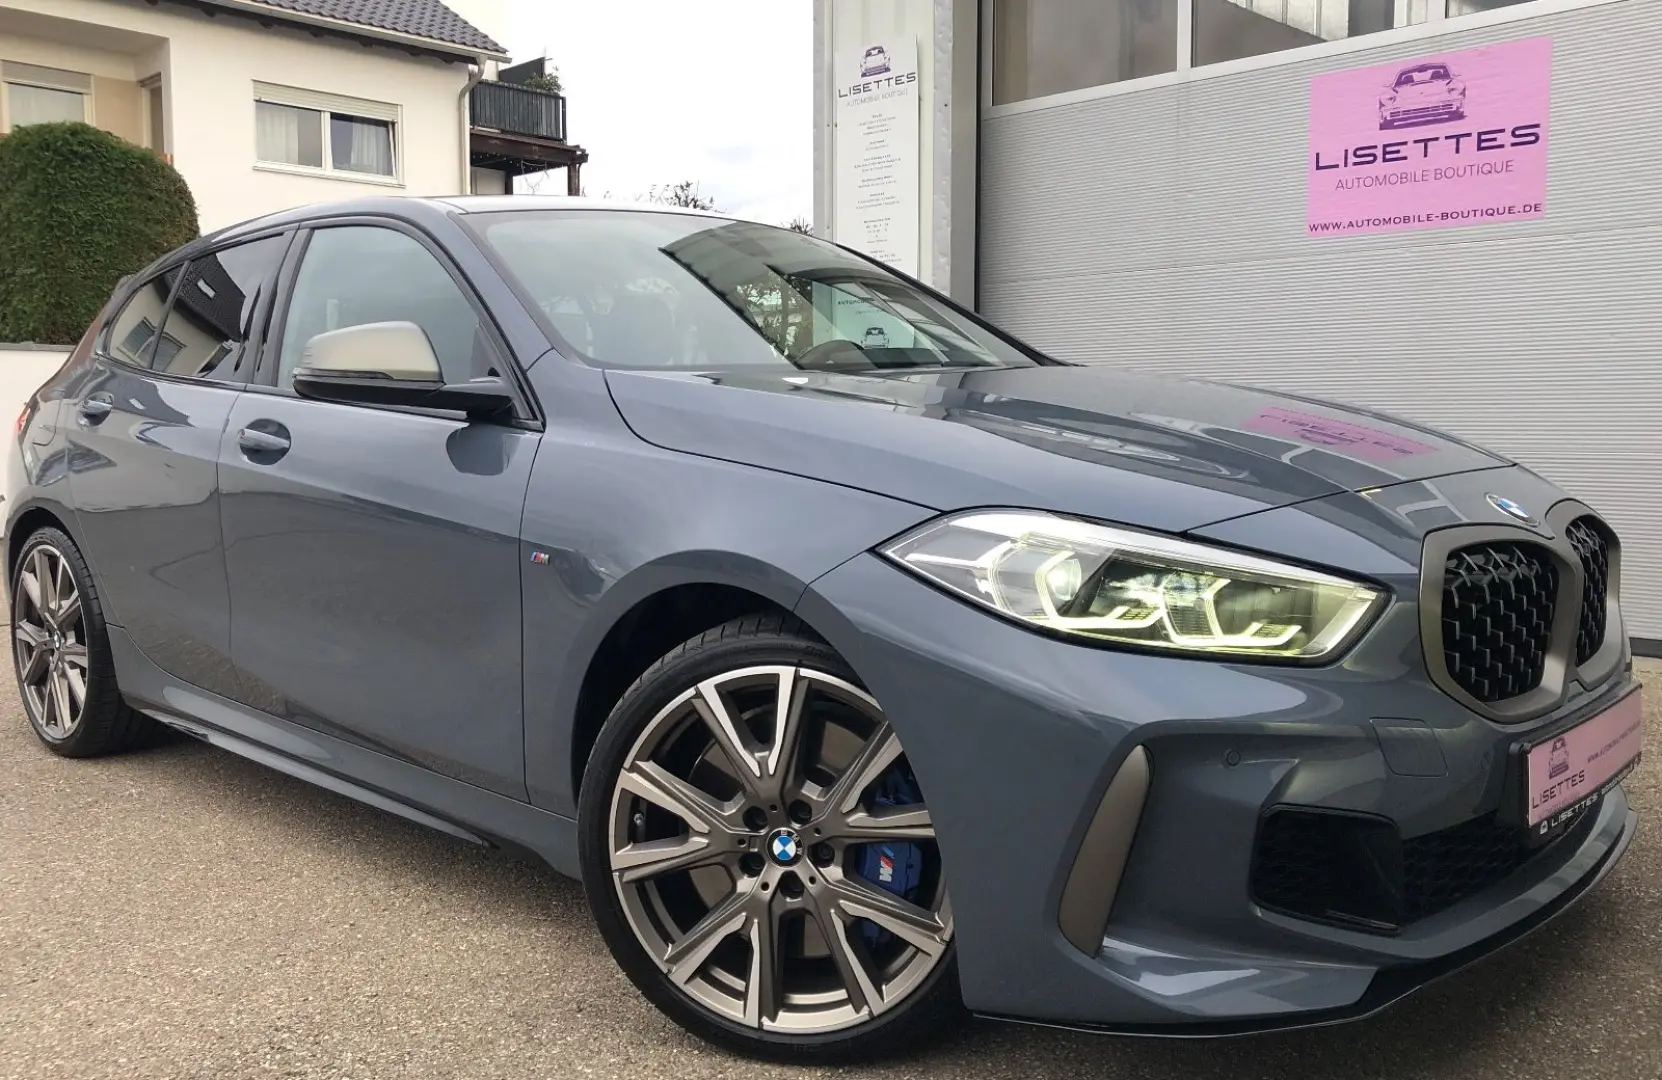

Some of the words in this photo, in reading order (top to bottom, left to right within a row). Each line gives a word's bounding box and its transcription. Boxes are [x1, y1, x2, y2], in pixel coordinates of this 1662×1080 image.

[838, 72, 916, 98] LISETTES
[1315, 123, 1541, 171] LISETTES
[1335, 169, 1430, 191] AUTOMOBILE
[1433, 159, 1515, 183] BOUTIQUE
[1308, 203, 1543, 232] WWW.AUTOMOBILE-BOUTIQUE.DE
[1532, 770, 1586, 810] LISETTES
[1551, 792, 1599, 828] LISETTES
